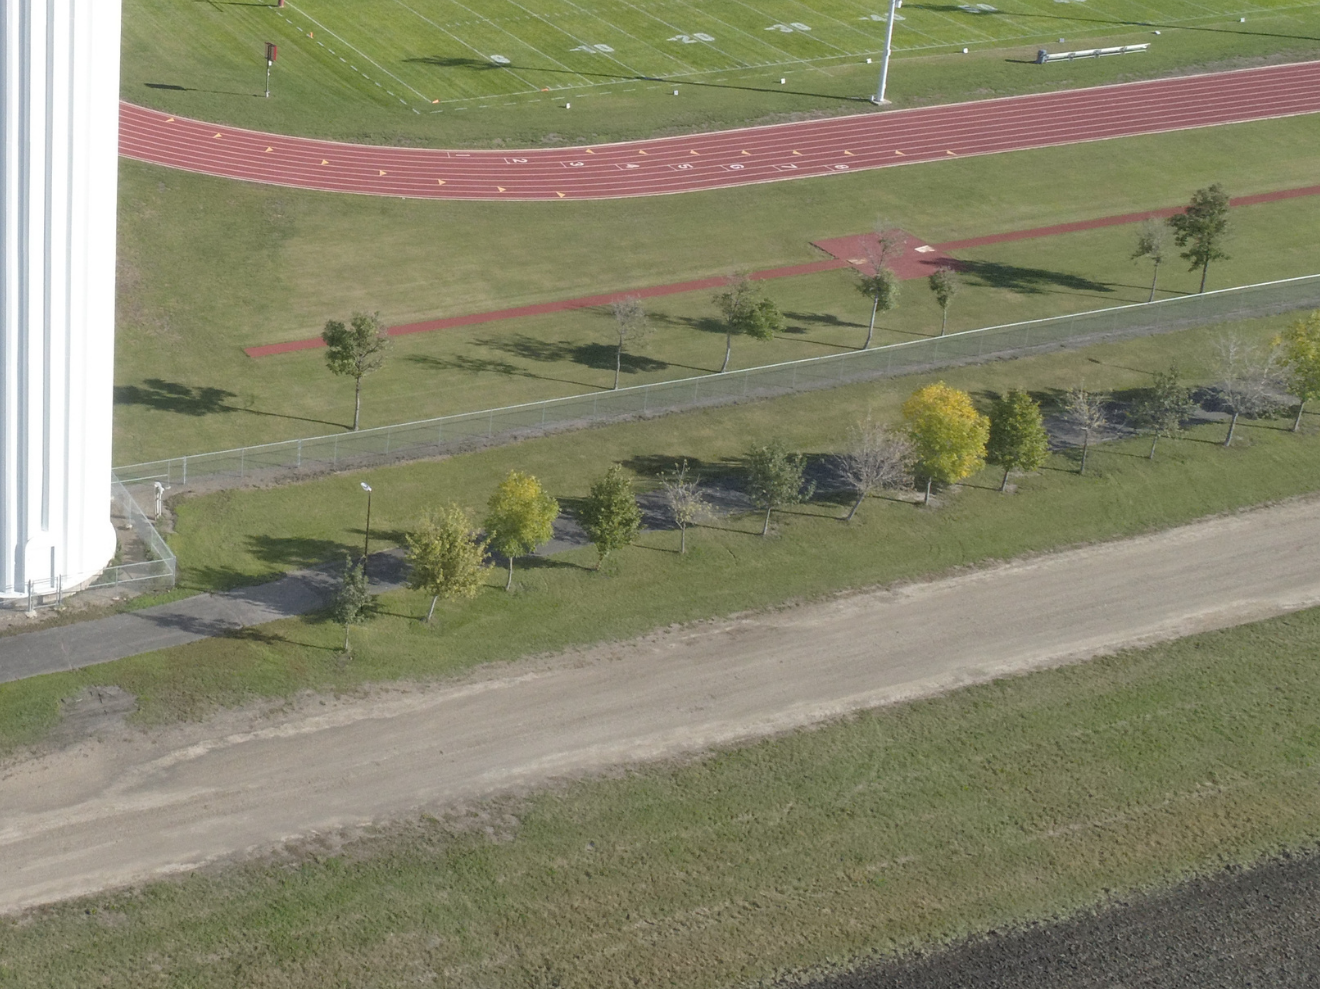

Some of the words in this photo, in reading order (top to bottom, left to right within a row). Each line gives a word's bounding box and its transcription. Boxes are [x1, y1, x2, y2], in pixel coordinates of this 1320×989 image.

[772, 22, 811, 33] 30
[674, 33, 715, 44] 20
[578, 43, 615, 54] 10
